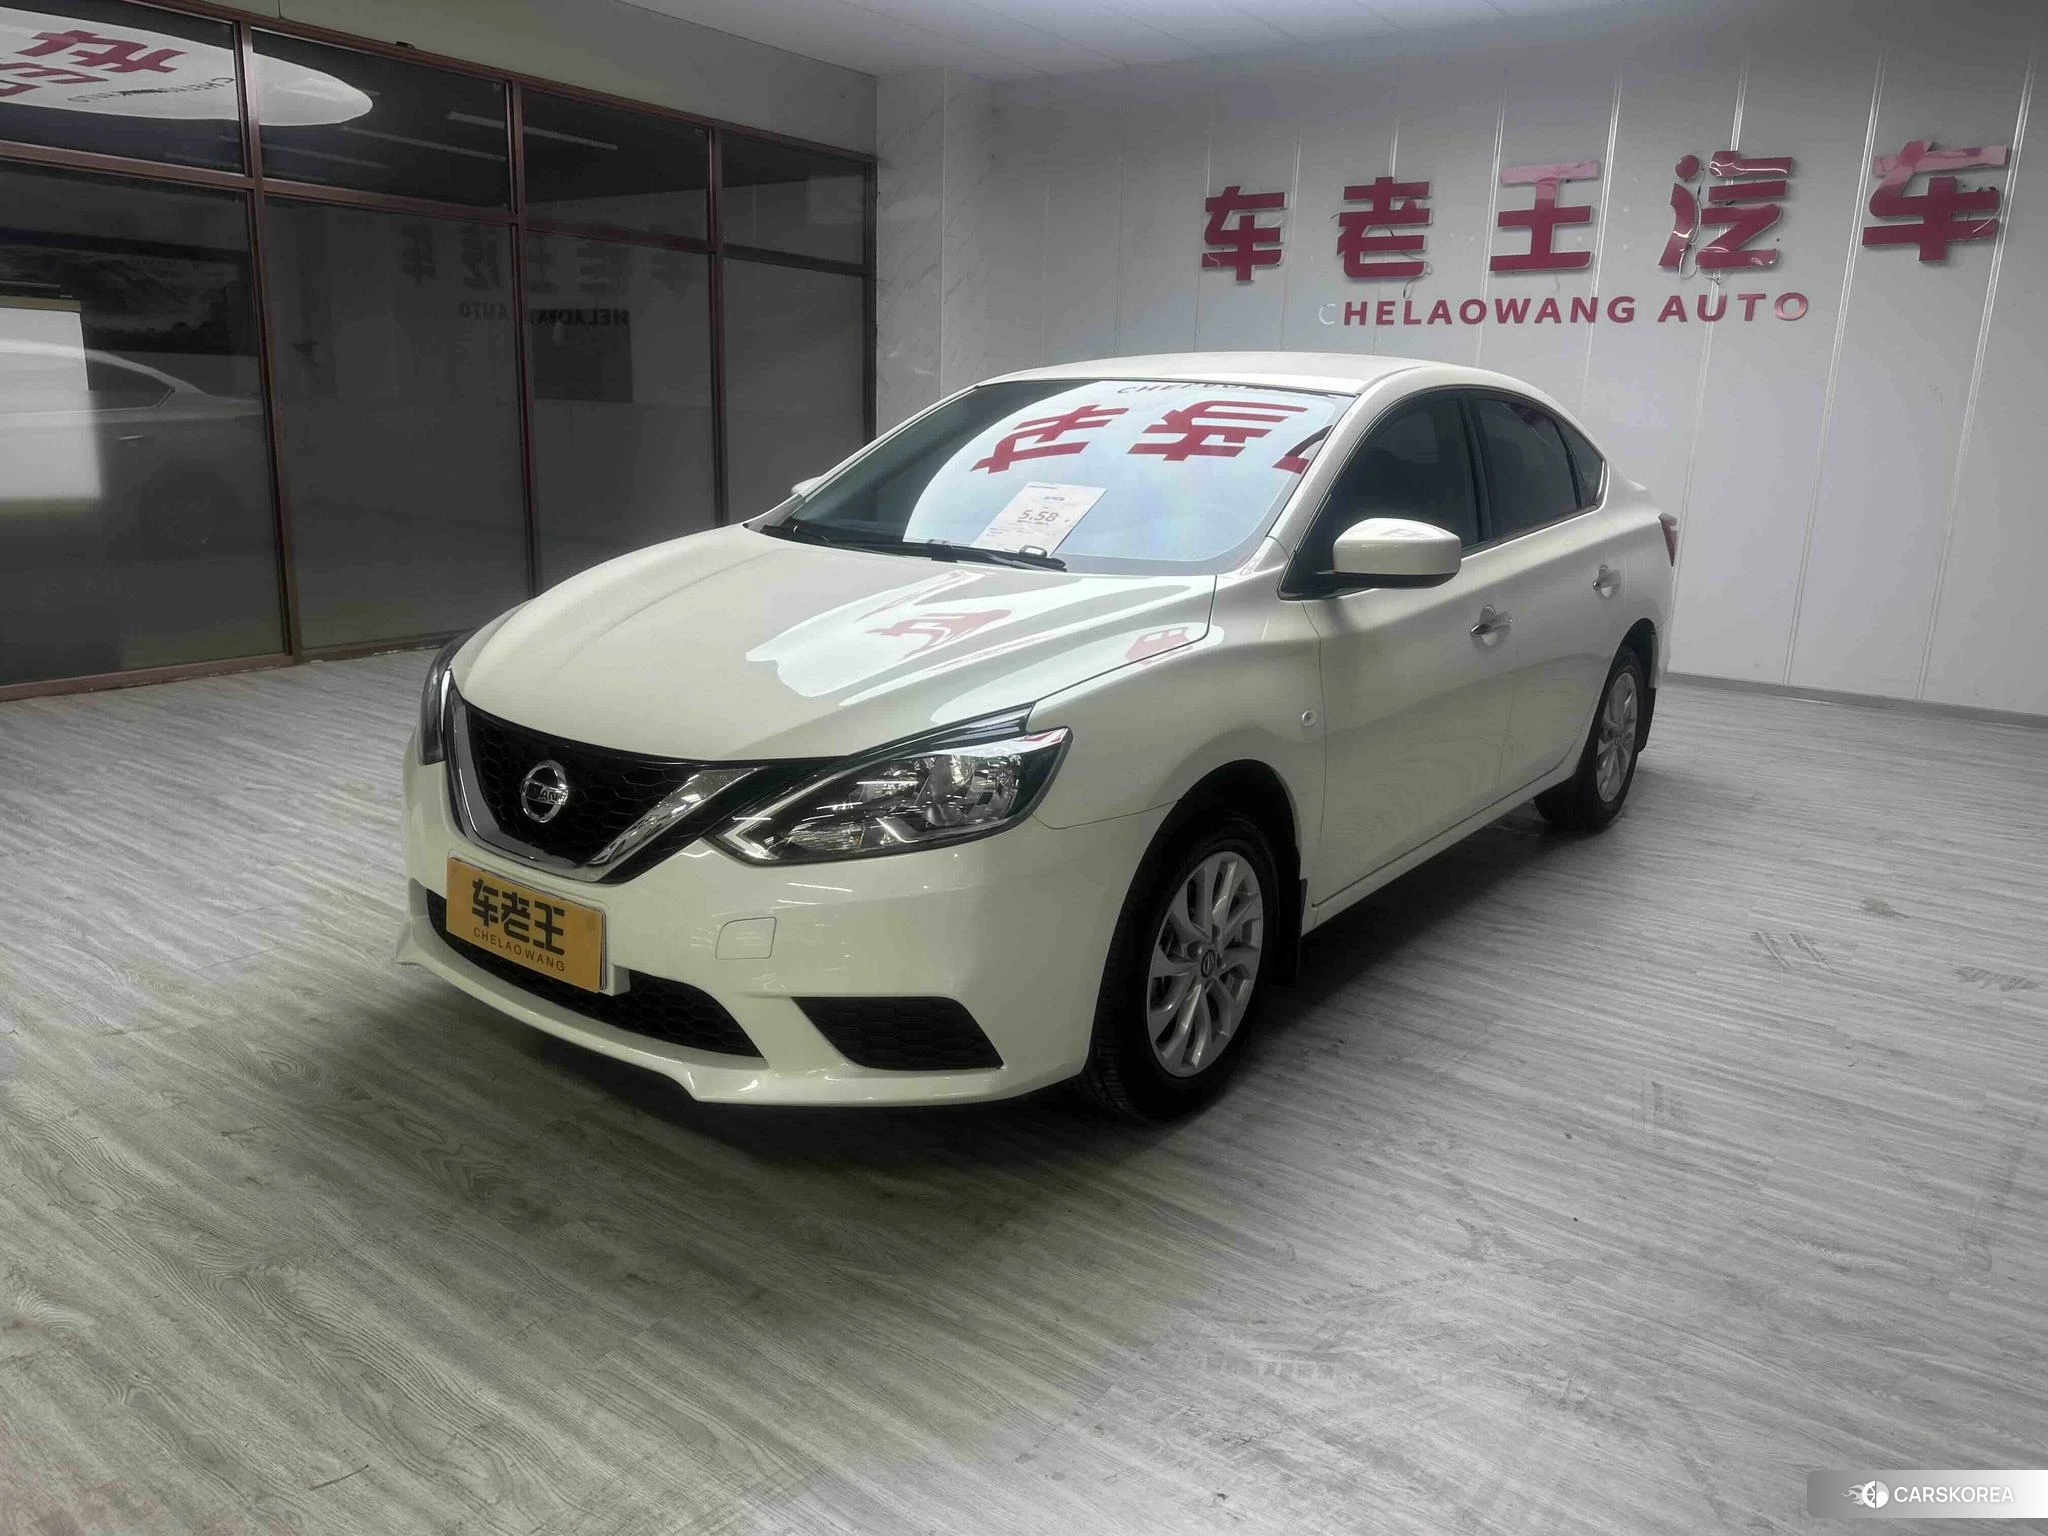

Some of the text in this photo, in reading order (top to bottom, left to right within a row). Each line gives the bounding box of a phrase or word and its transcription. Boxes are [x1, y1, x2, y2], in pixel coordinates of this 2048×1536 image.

[1202, 141, 2010, 284] 车老王汽车
[1318, 291, 1810, 327] CHELAOWANG AUTO
[1018, 508, 1060, 523] 5.58
[471, 877, 566, 957] 车老王
[472, 925, 566, 973] CHELAOWANG
